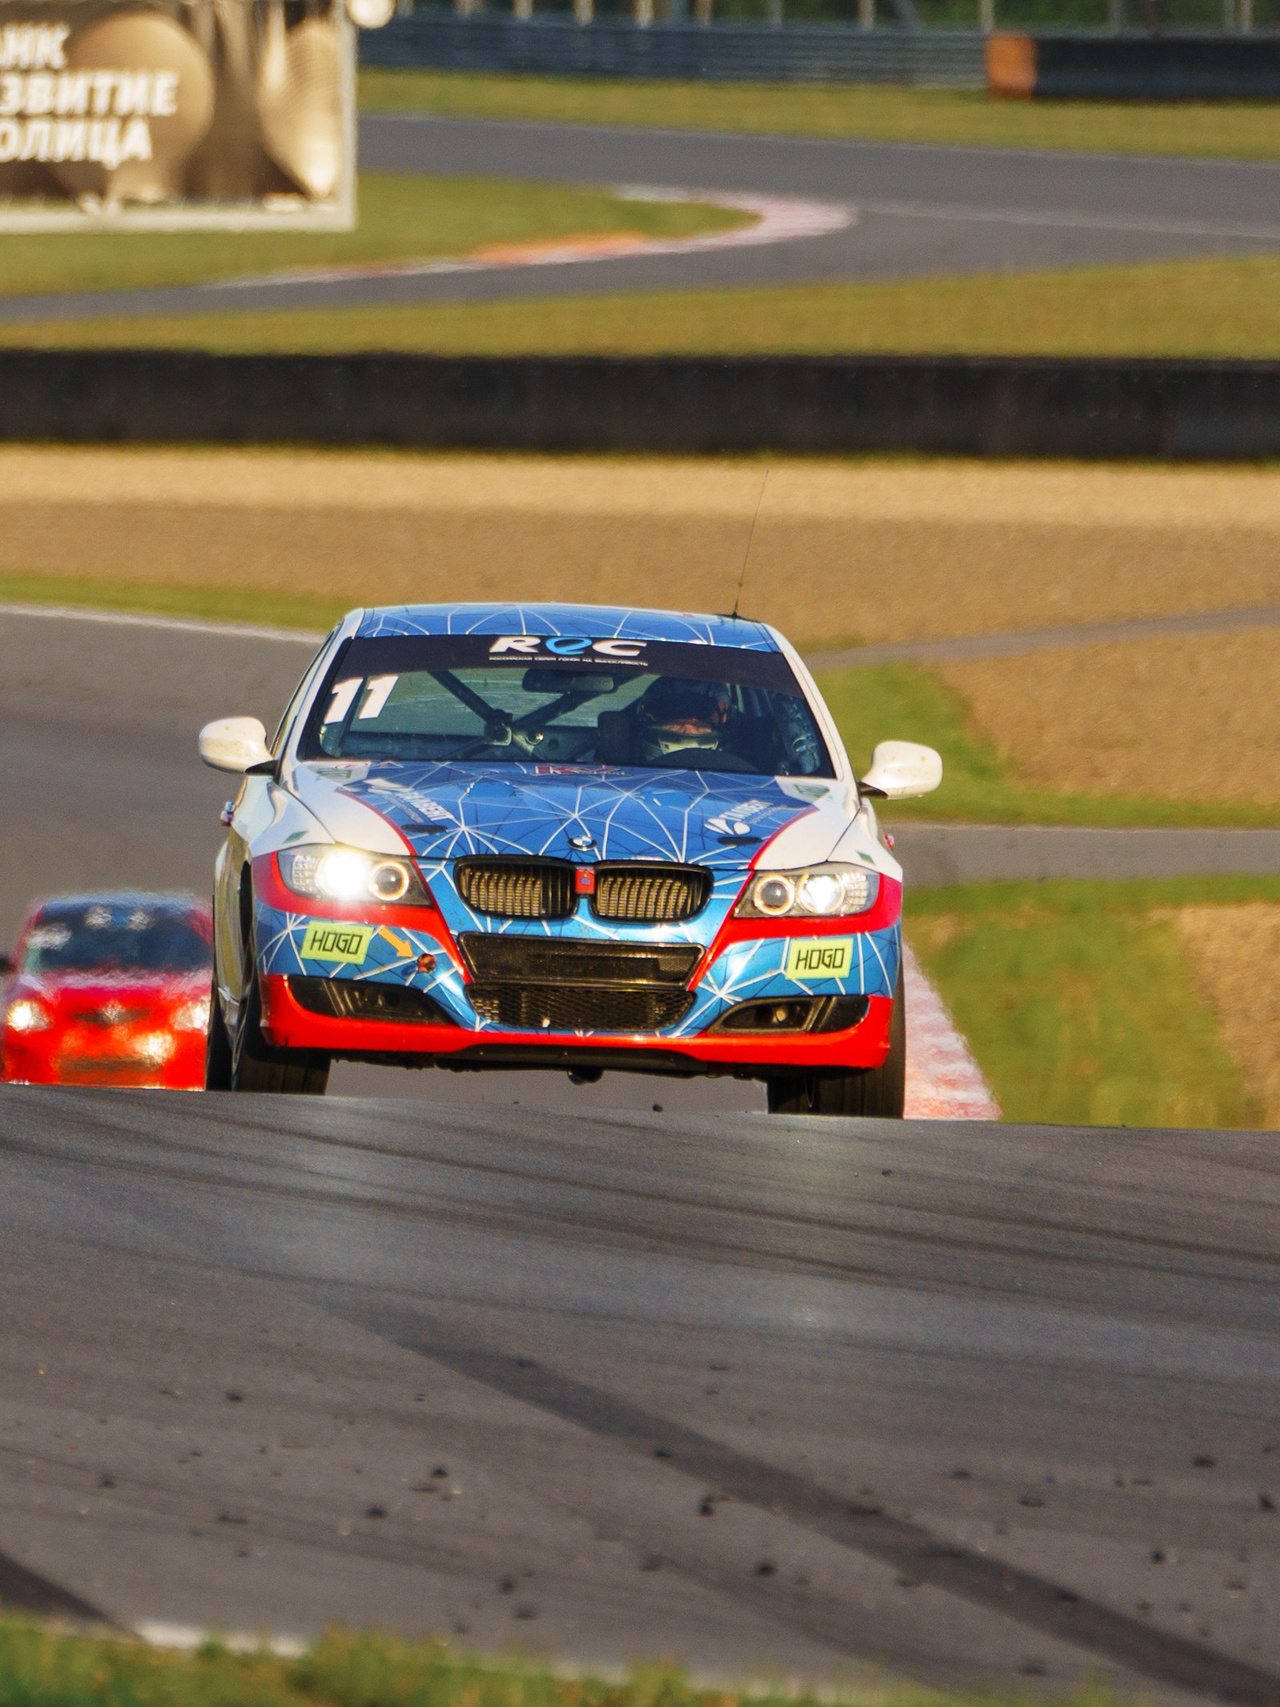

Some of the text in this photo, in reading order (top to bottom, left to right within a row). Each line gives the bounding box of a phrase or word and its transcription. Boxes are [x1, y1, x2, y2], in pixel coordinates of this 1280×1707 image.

[323, 674, 399, 725] 11
[309, 929, 363, 956] HOGO
[795, 947, 846, 971] HOGO
